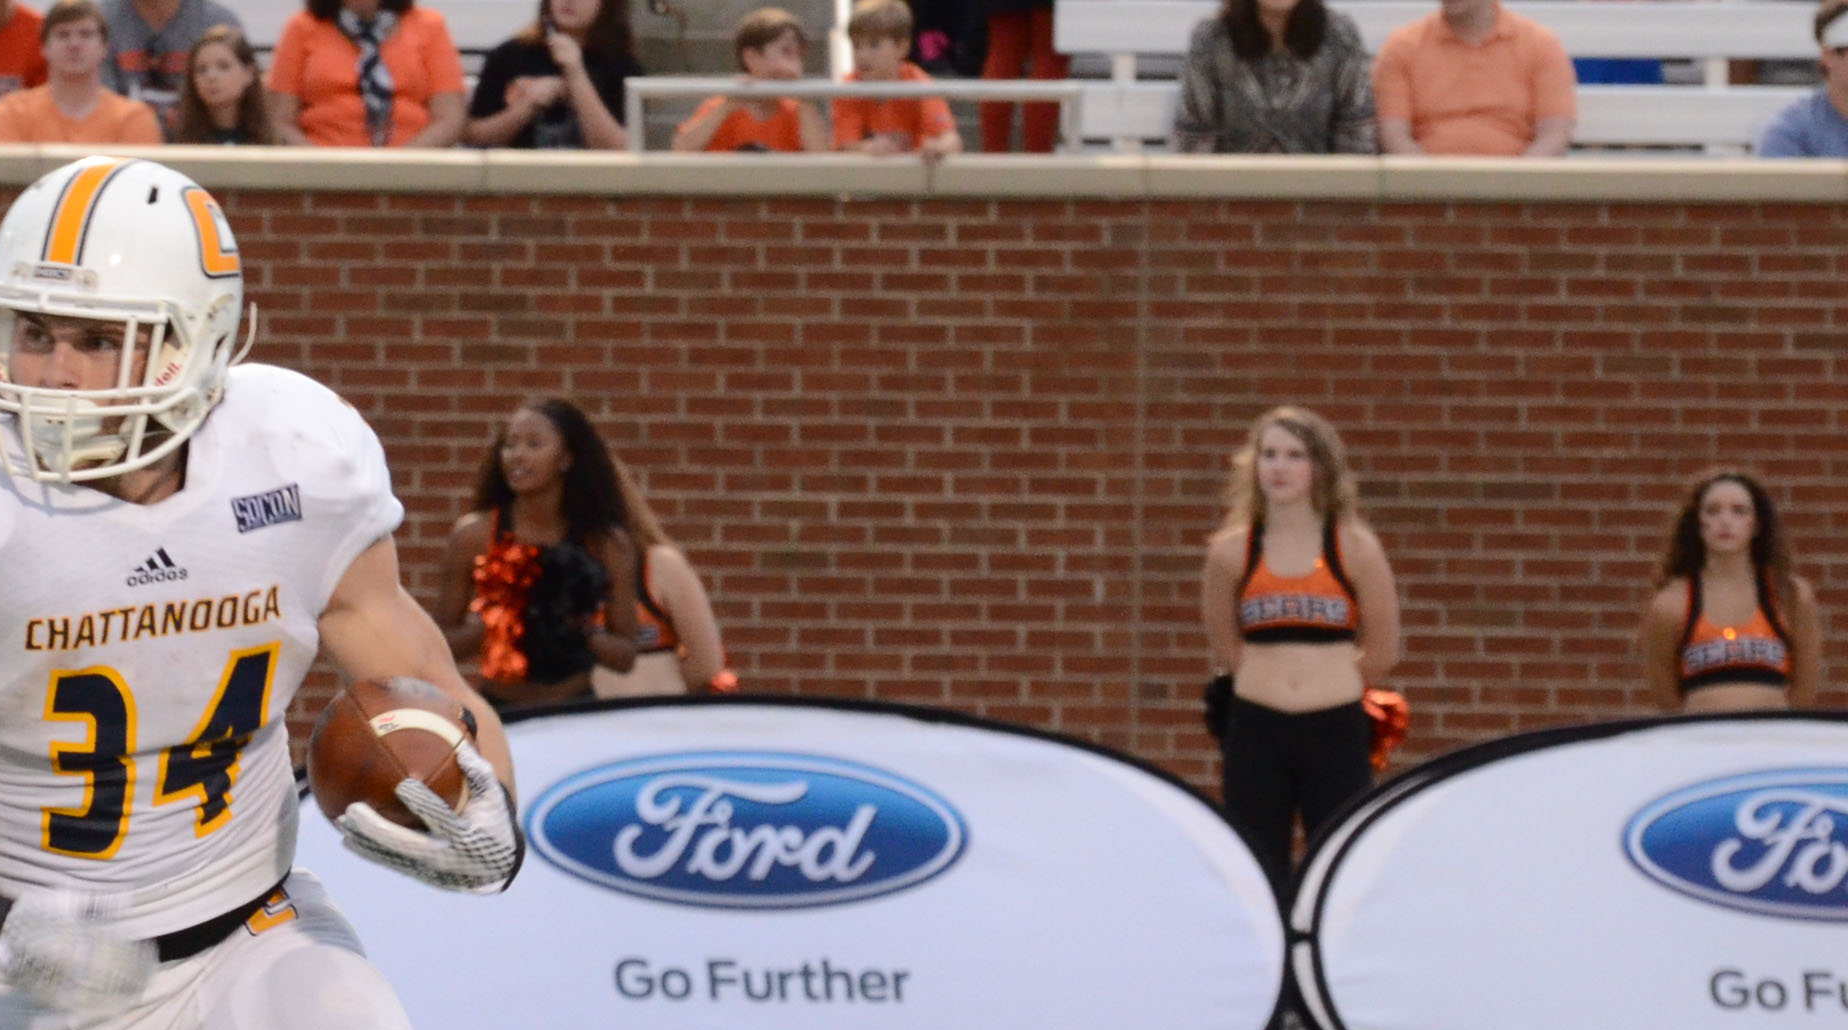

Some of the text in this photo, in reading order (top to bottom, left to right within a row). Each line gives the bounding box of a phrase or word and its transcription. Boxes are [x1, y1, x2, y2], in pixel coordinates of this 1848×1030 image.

[232, 484, 302, 533] SOCON
[126, 568, 188, 588] adidas
[25, 584, 281, 651] CHATTANOOGA
[40, 640, 282, 861] 34
[613, 773, 878, 882] Ford
[614, 958, 910, 1003] Go Further
[1709, 969, 1787, 1012] Go
